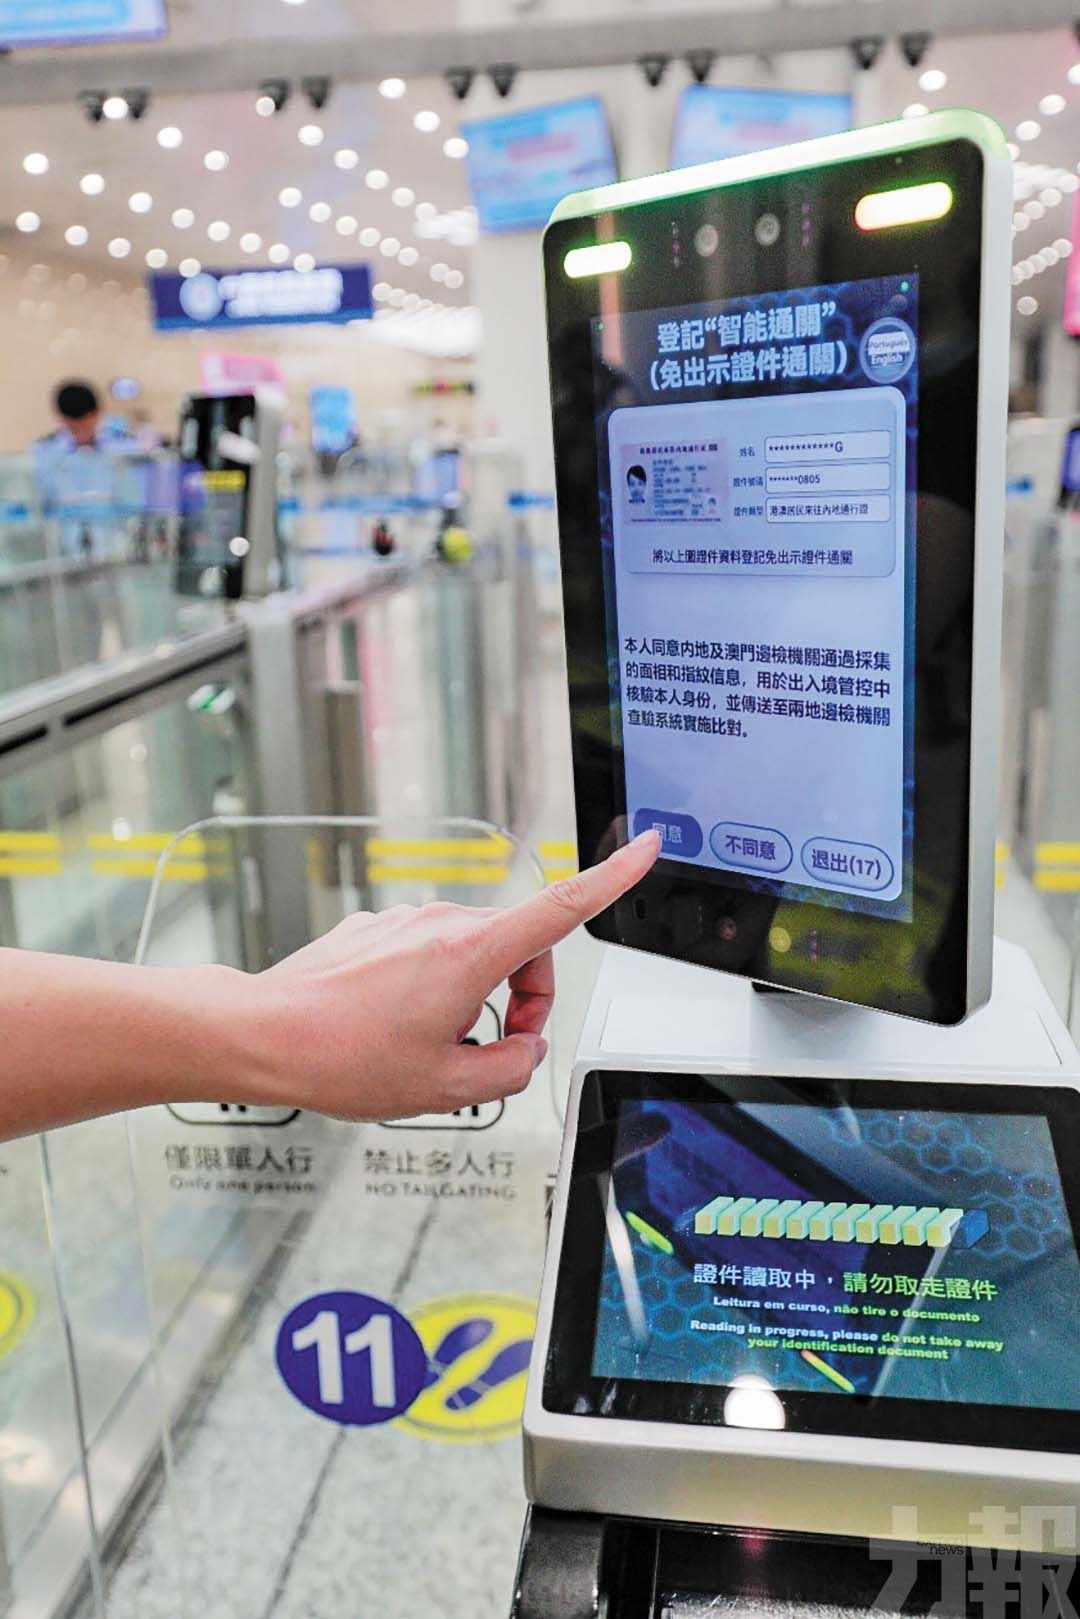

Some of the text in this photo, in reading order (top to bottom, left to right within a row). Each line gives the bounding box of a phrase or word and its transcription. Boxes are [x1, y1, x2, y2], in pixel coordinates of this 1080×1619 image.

[657, 301, 836, 353] 登記“智能通關”
[872, 352, 904, 366] English
[725, 834, 776, 861] 不同意
[811, 849, 881, 880] 退出(17)
[364, 1149, 516, 1177] 禁止多人行
[366, 1183, 397, 1197] NO
[713, 1296, 760, 1309] Leitura
[764, 1301, 785, 1310] em
[788, 1302, 831, 1315] curso,
[890, 1308, 899, 1317] o
[902, 1308, 981, 1323] documento
[690, 1320, 1004, 1353] Reading in progress, please do not take away
[747, 1337, 950, 1360] your identification document
[292, 1310, 396, 1408] 11
